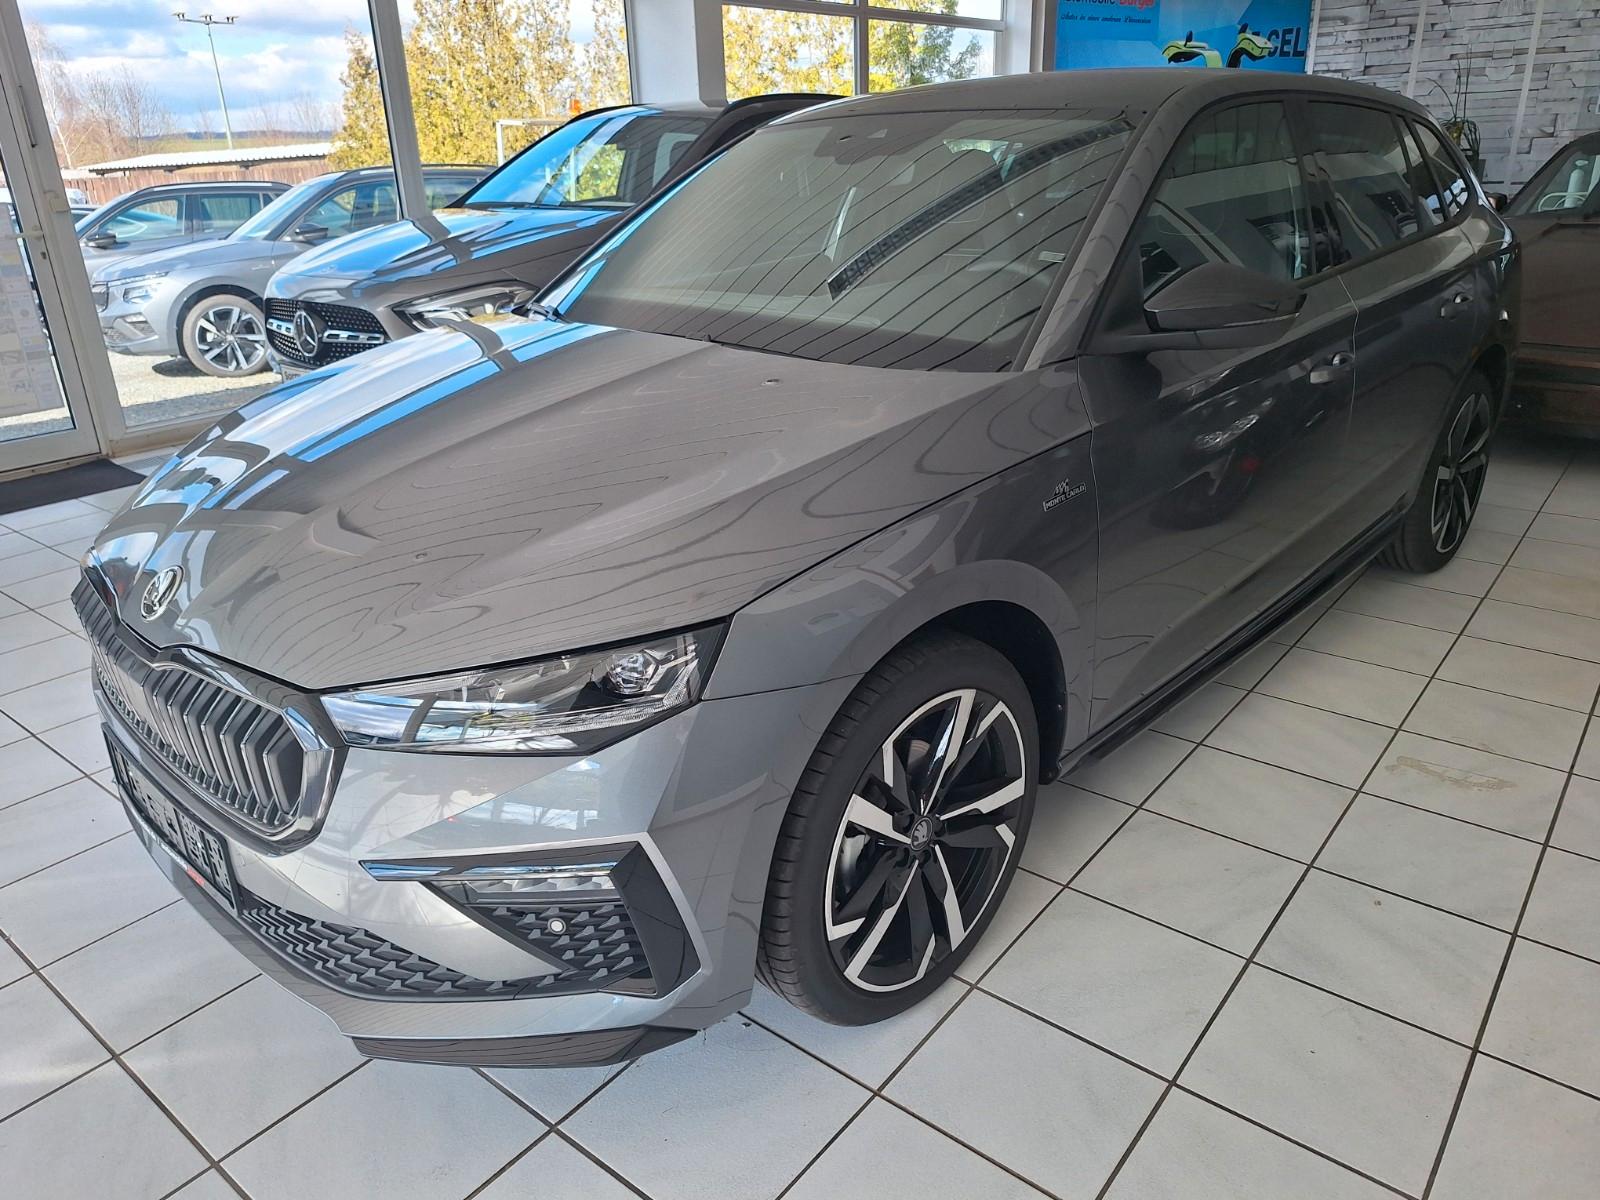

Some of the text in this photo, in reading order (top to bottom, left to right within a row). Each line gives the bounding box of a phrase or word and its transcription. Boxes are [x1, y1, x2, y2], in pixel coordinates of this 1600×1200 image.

[1252, 27, 1305, 57] CEL
[1046, 485, 1085, 509] MONTE CARLO
